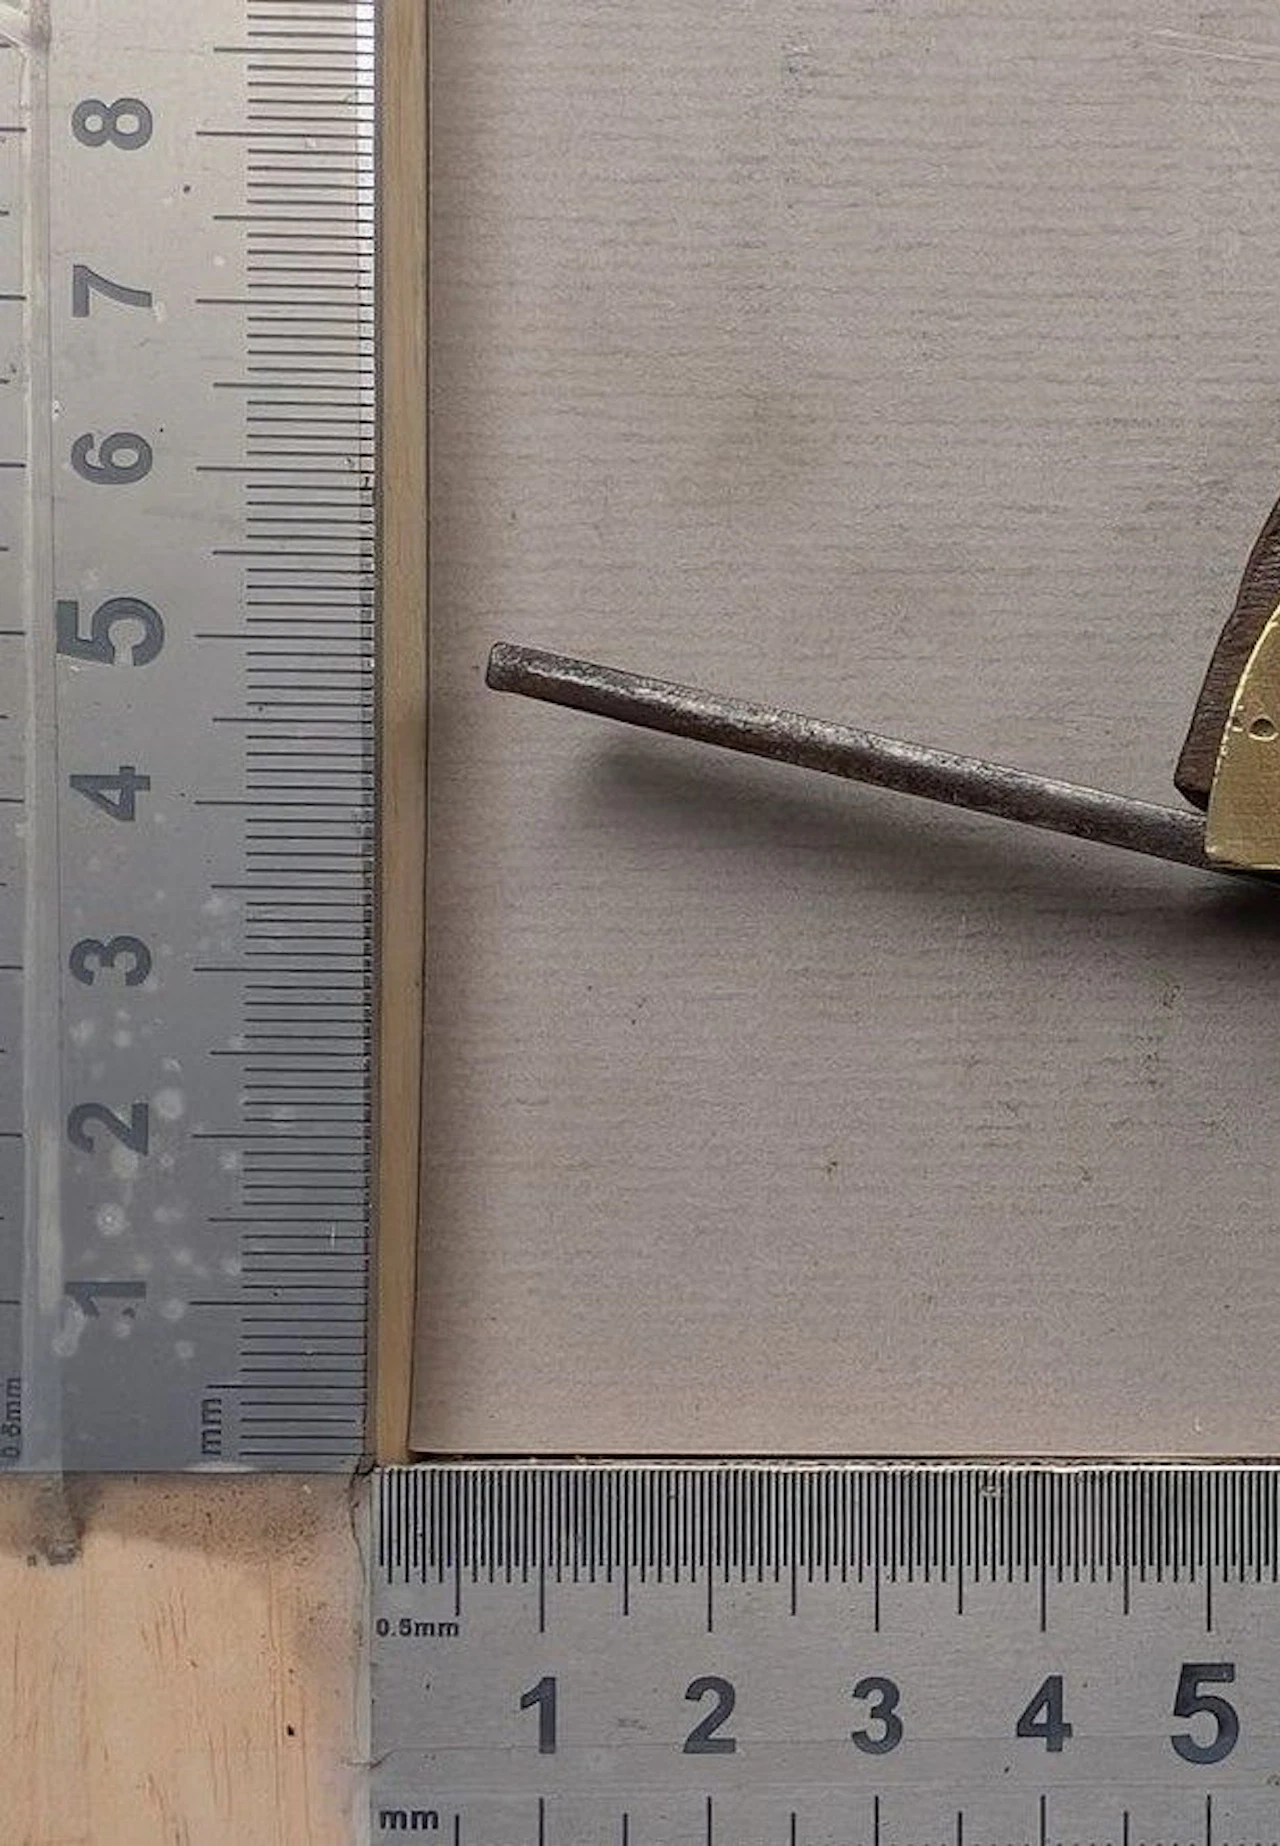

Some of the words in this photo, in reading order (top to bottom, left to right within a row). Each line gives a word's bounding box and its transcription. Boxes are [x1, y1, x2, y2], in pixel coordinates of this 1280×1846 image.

[71, 97, 153, 151] 8
[72, 264, 153, 317] 7
[71, 432, 153, 485] 6
[56, 597, 165, 666] 5
[69, 766, 151, 821] 4
[69, 935, 152, 987] 3
[67, 1101, 150, 1156] 2
[65, 1281, 146, 1317] 1
[202, 1398, 222, 1455] mm
[376, 1618, 459, 1637] 0.5mm
[519, 1677, 557, 1754] 1
[683, 1677, 736, 1754] 2
[851, 1677, 904, 1755] 3
[1016, 1676, 1073, 1752] 4
[1170, 1663, 1239, 1764] 5
[380, 1810, 439, 1830] mm
